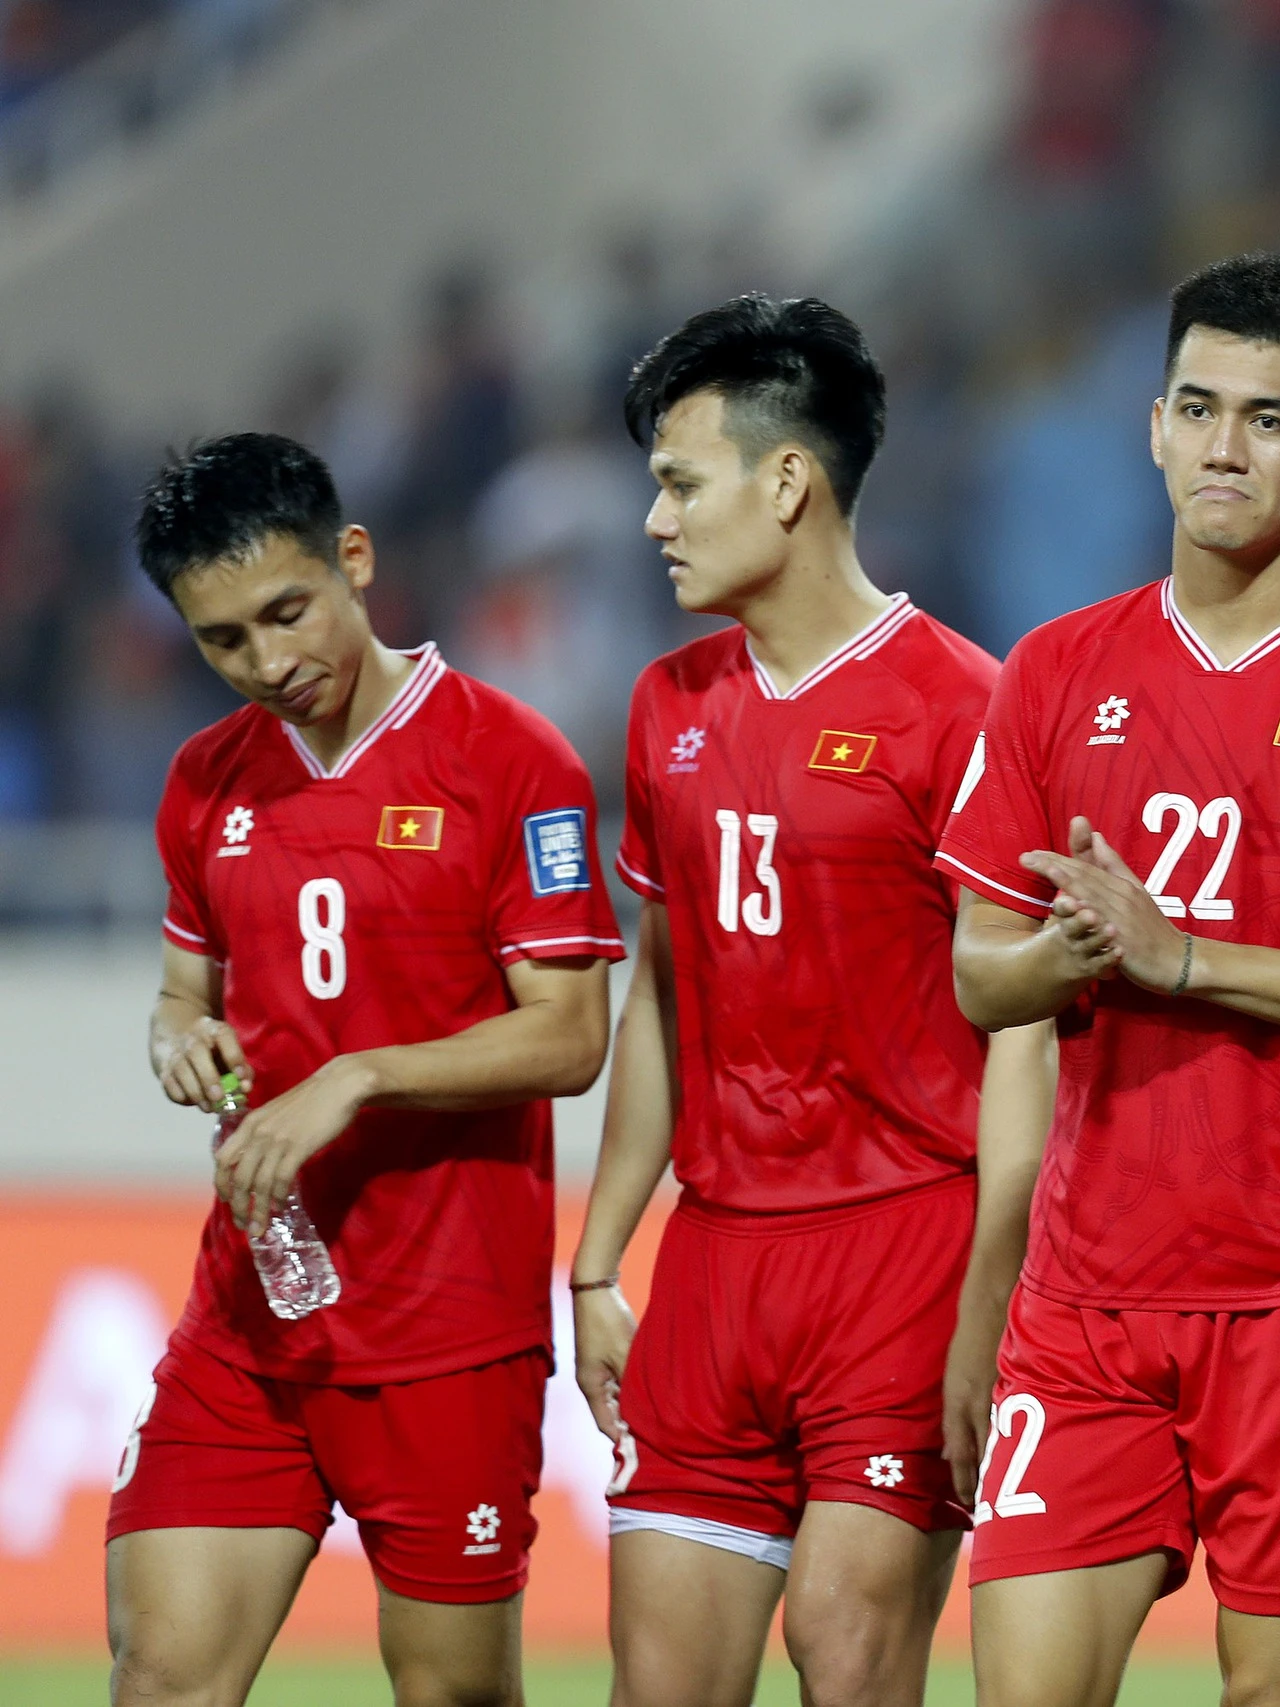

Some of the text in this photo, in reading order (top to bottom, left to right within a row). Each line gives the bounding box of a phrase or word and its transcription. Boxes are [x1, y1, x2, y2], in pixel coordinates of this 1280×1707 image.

[715, 809, 782, 936] 13
[1142, 792, 1242, 920] 22
[298, 877, 346, 1000] 8
